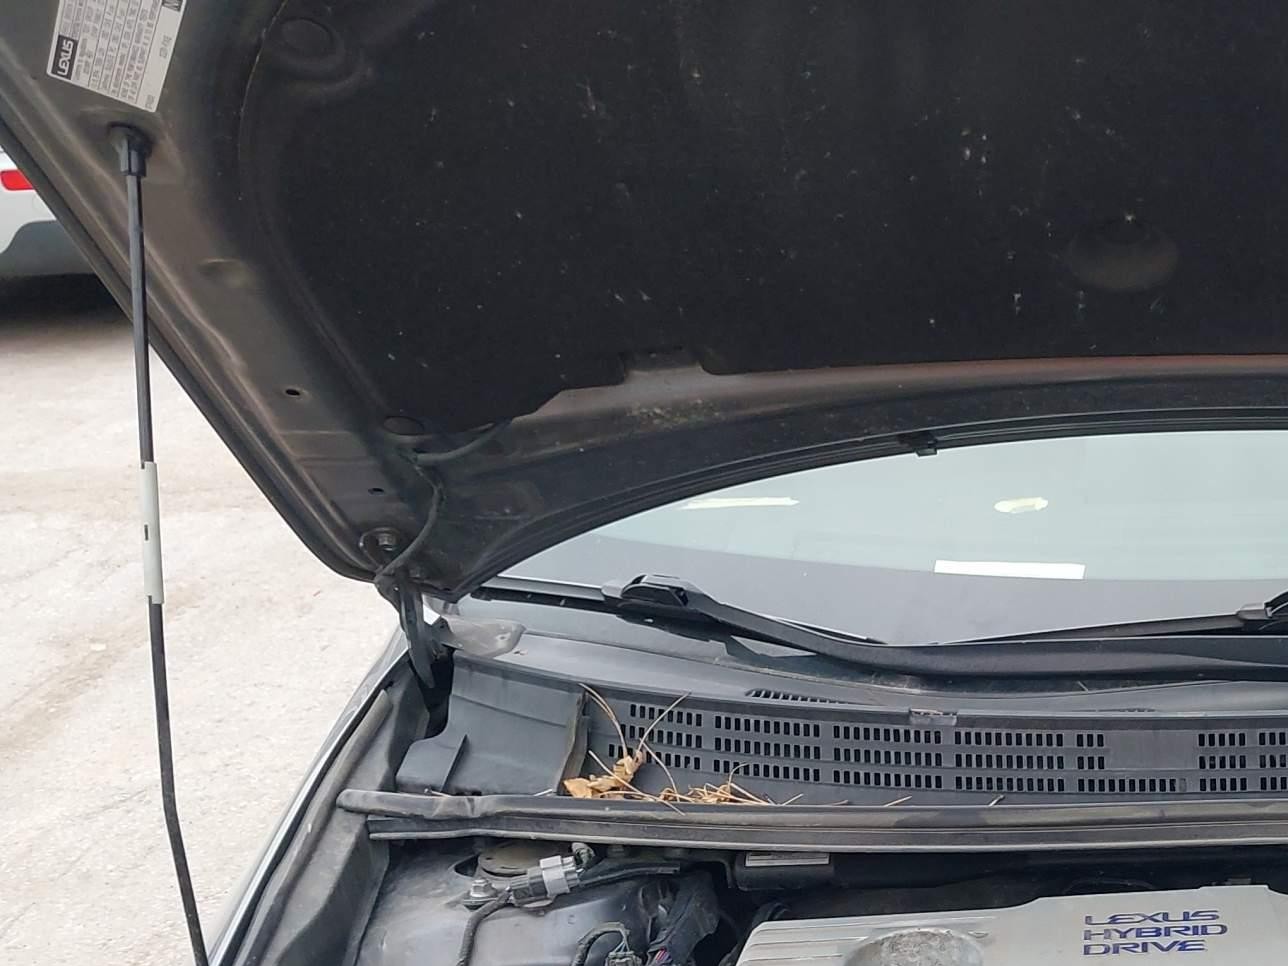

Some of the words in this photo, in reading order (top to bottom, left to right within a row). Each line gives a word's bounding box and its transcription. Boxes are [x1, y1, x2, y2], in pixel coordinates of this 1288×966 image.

[57, 39, 74, 76] LEXUS
[1085, 910, 1219, 925] LEXUS
[1083, 924, 1228, 940] HYBRID
[1083, 939, 1206, 956] DRIVE
